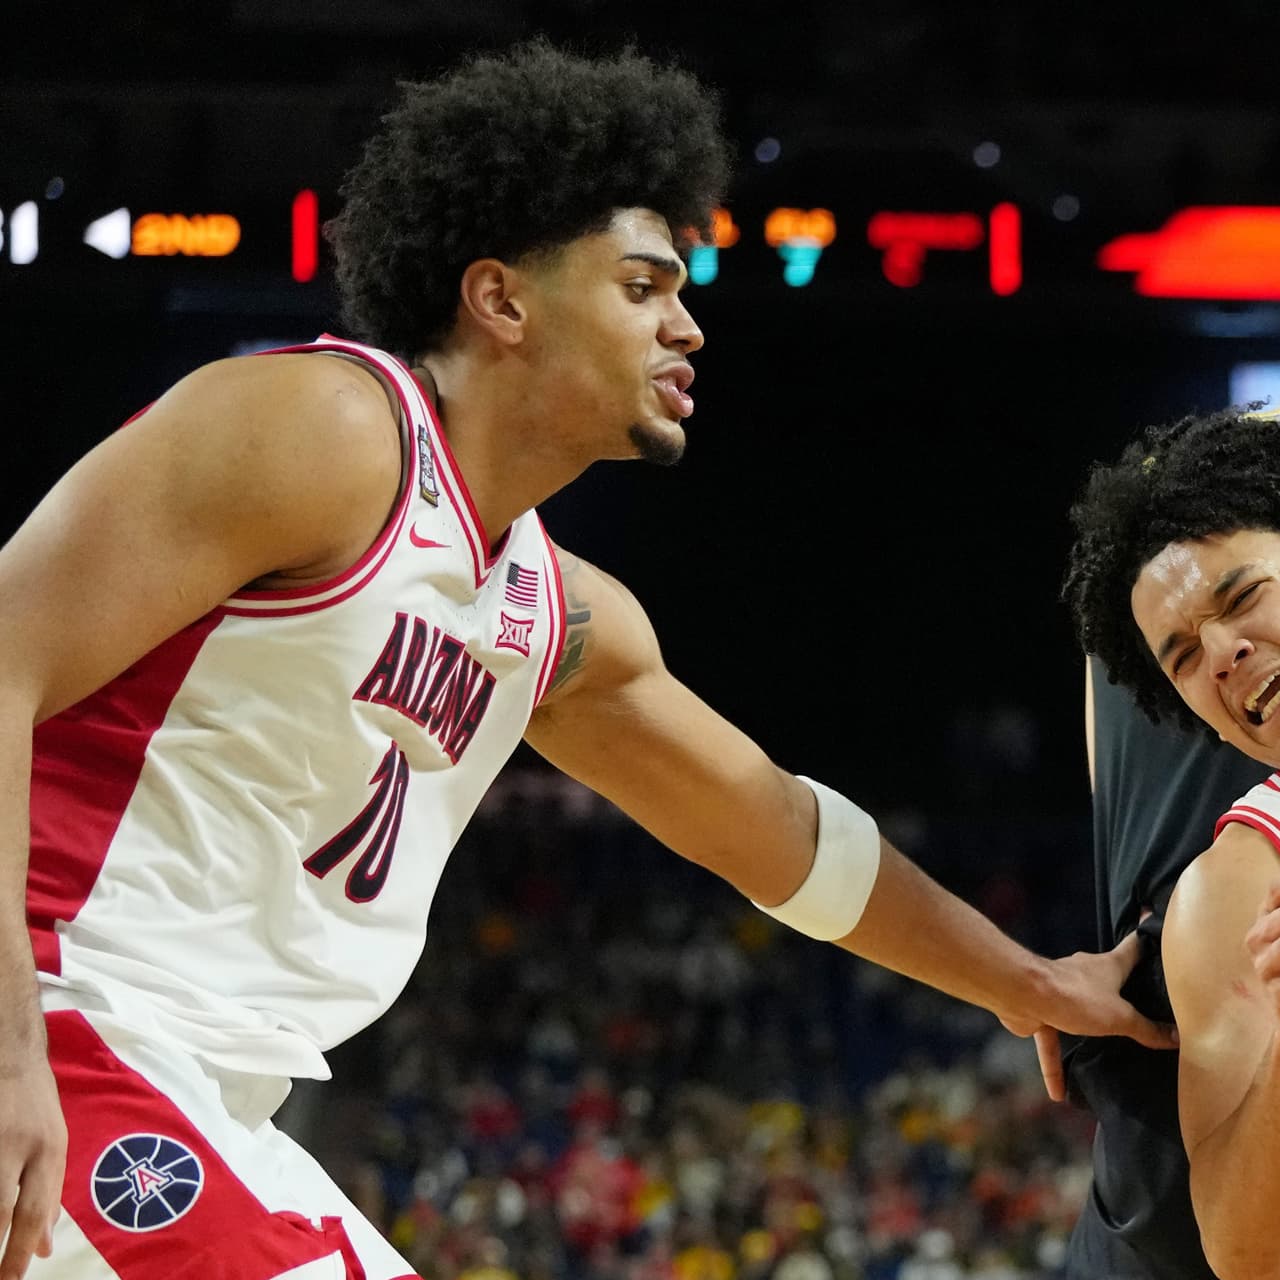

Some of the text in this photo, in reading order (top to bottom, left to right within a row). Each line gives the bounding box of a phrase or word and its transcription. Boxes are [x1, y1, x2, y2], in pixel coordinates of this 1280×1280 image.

[352, 612, 497, 766] ARIZONA
[303, 739, 410, 904] 10
[122, 1157, 172, 1205] A
